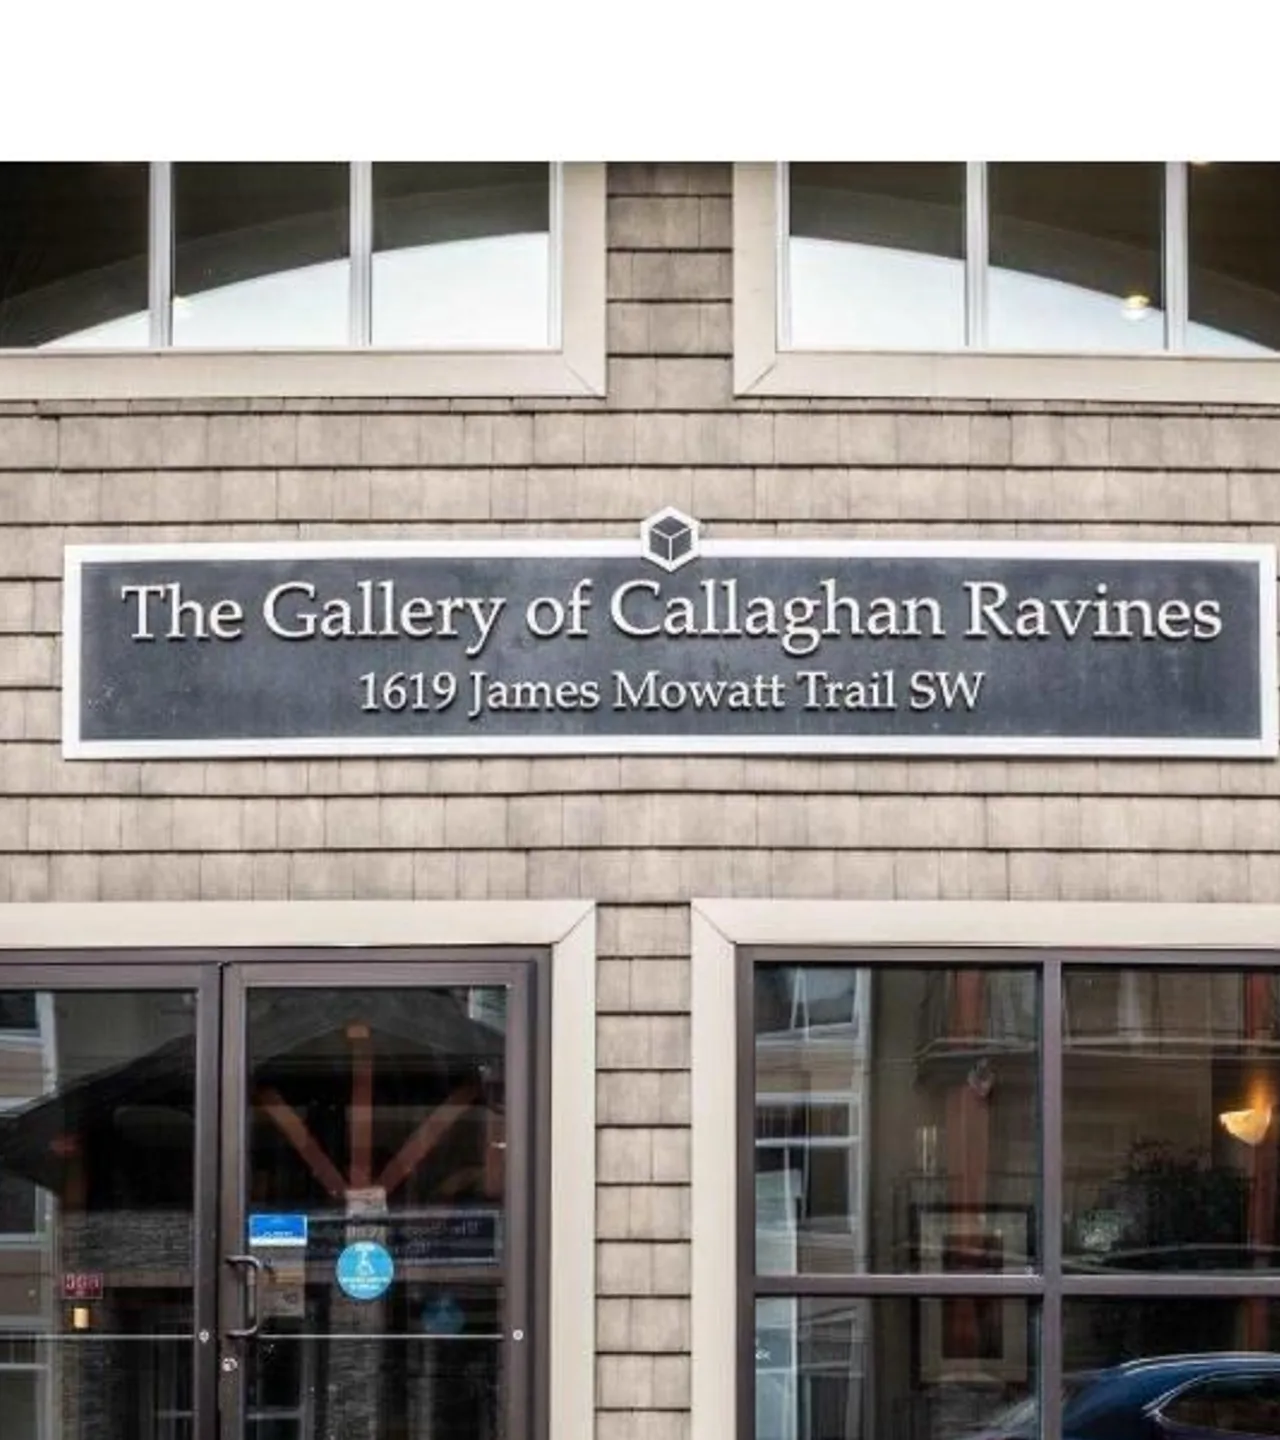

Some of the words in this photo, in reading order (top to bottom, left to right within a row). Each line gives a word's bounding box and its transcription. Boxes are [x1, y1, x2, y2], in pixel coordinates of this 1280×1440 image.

[120, 581, 243, 639] The
[262, 579, 507, 654] Gallery
[525, 577, 593, 636] of
[610, 577, 947, 654] Callaghan
[963, 580, 1223, 639] Ravines
[359, 670, 457, 710] 1619
[467, 670, 601, 717] James
[611, 670, 786, 708] Mowatt
[796, 669, 897, 709] Trail
[910, 670, 987, 710] SW
